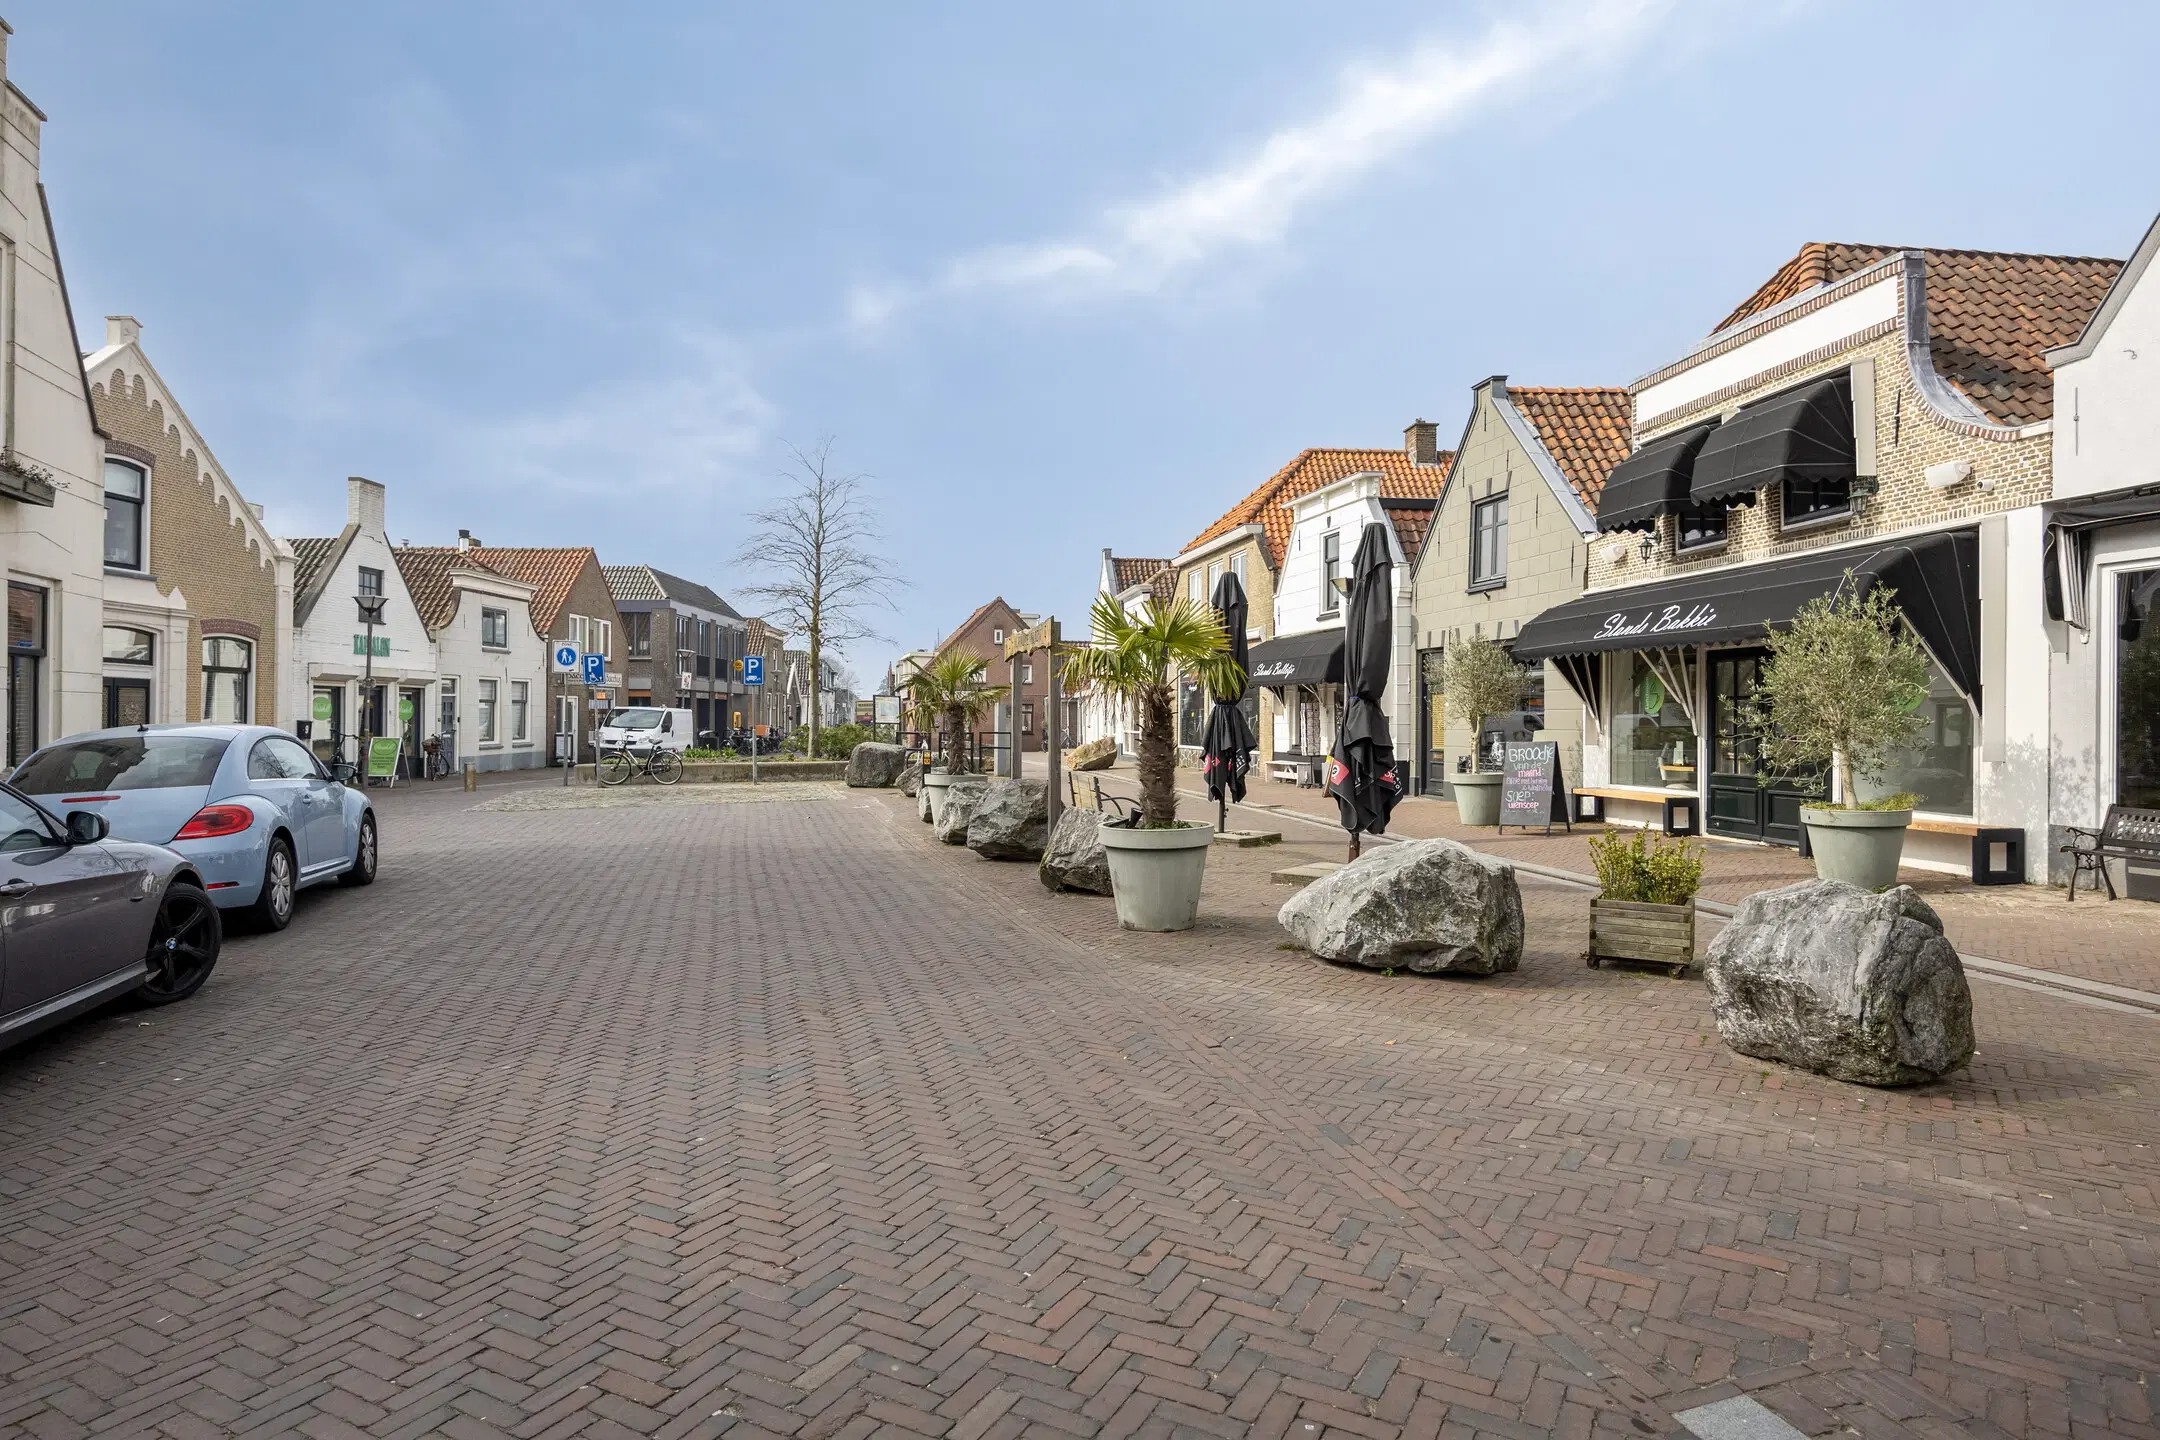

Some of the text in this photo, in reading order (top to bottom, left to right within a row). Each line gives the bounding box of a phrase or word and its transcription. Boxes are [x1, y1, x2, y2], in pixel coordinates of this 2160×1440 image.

[1650, 603, 1717, 632] Bakkie
[354, 634, 390, 657] KAPALON
[588, 657, 599, 672] P
[748, 659, 759, 673] P
